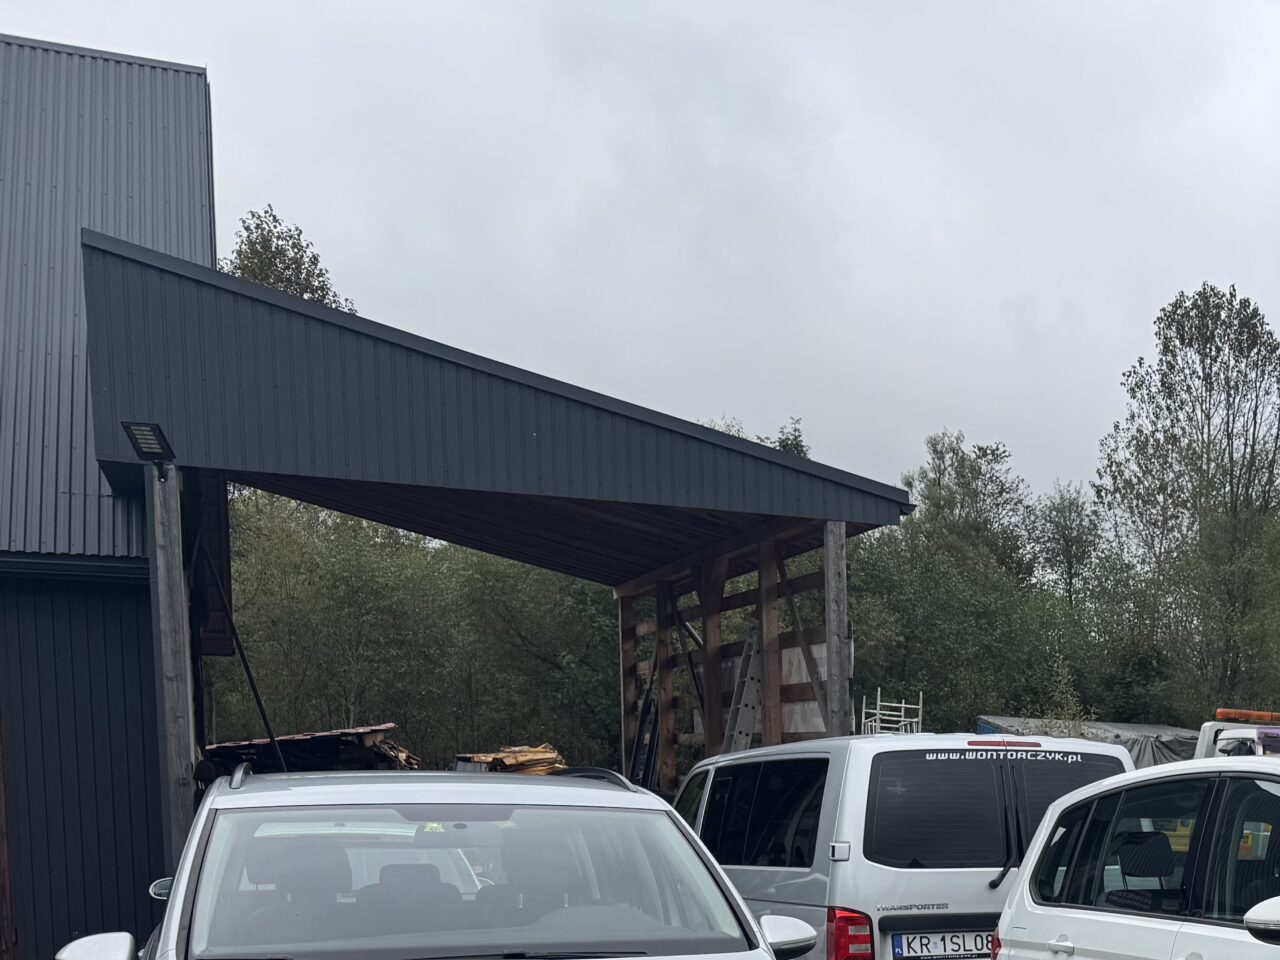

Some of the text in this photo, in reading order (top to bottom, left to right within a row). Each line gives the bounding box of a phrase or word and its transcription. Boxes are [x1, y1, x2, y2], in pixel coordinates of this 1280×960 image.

[875, 903, 949, 911] TRANSPORTER
[906, 934, 992, 954] KR 1SL08
